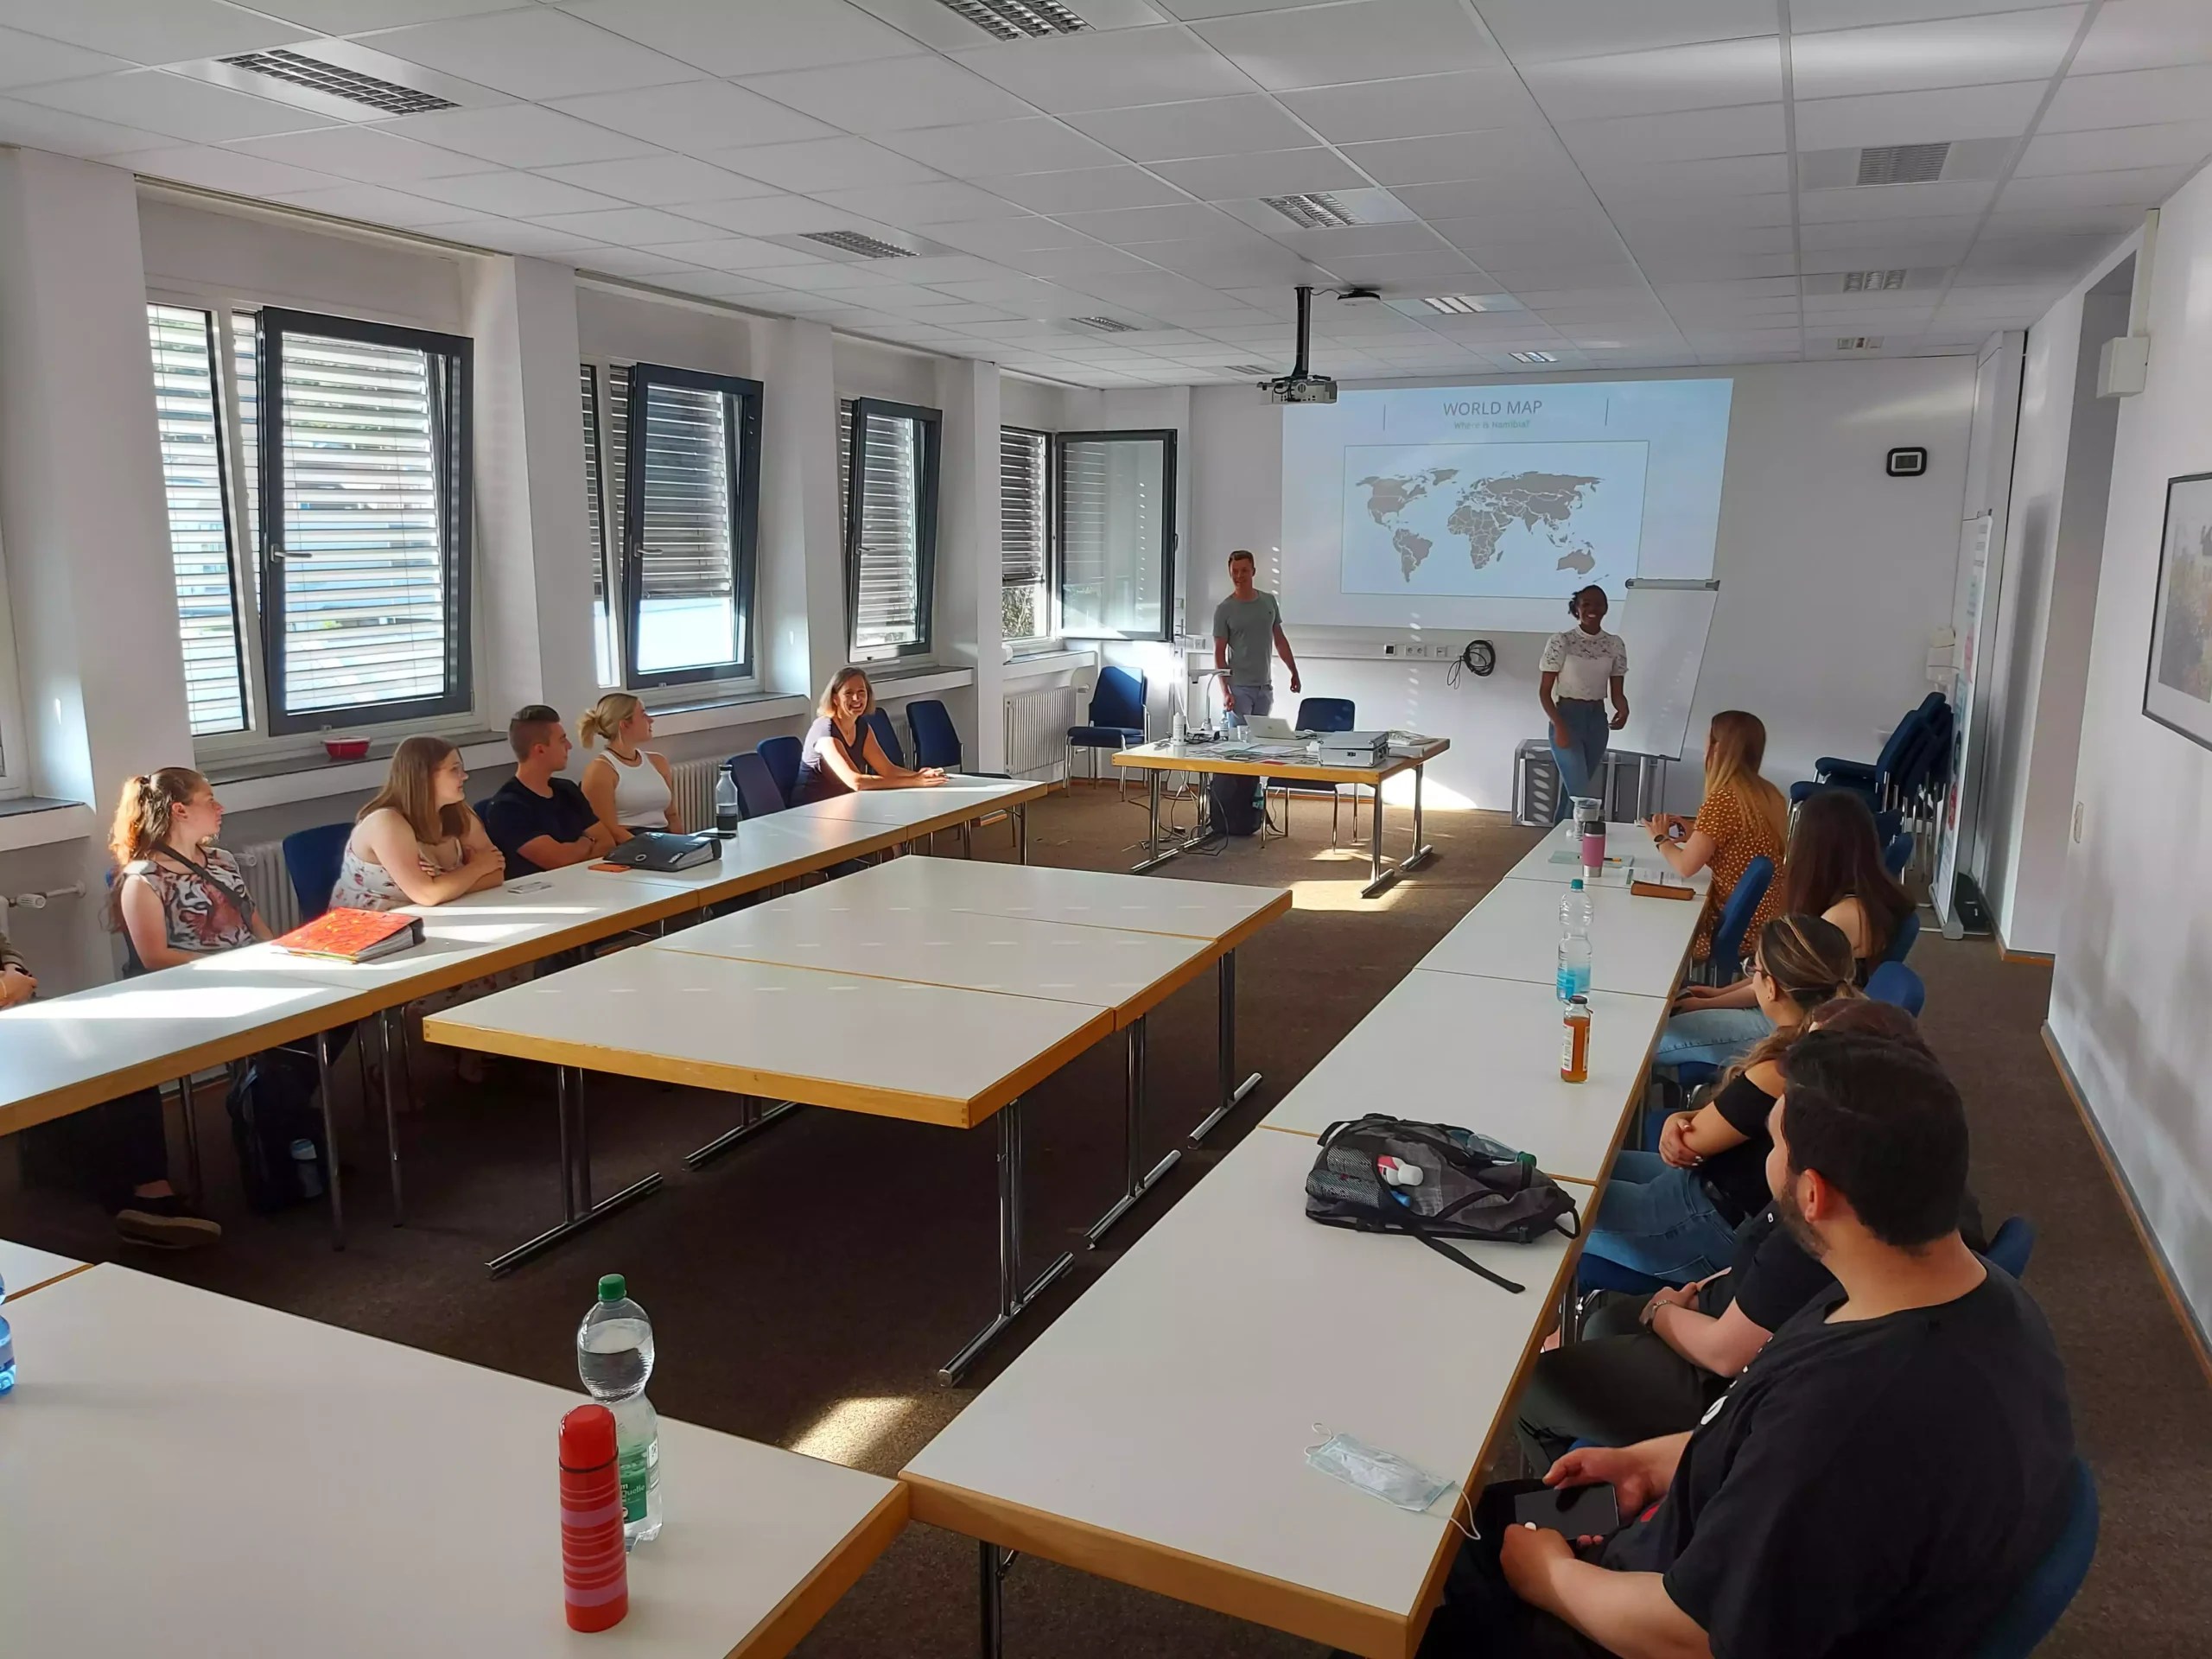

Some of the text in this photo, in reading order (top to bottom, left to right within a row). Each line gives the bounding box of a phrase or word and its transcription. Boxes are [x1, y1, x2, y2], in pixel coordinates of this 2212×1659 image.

[1443, 400, 1542, 416] WORLD MAP
[1454, 421, 1480, 429] Where
